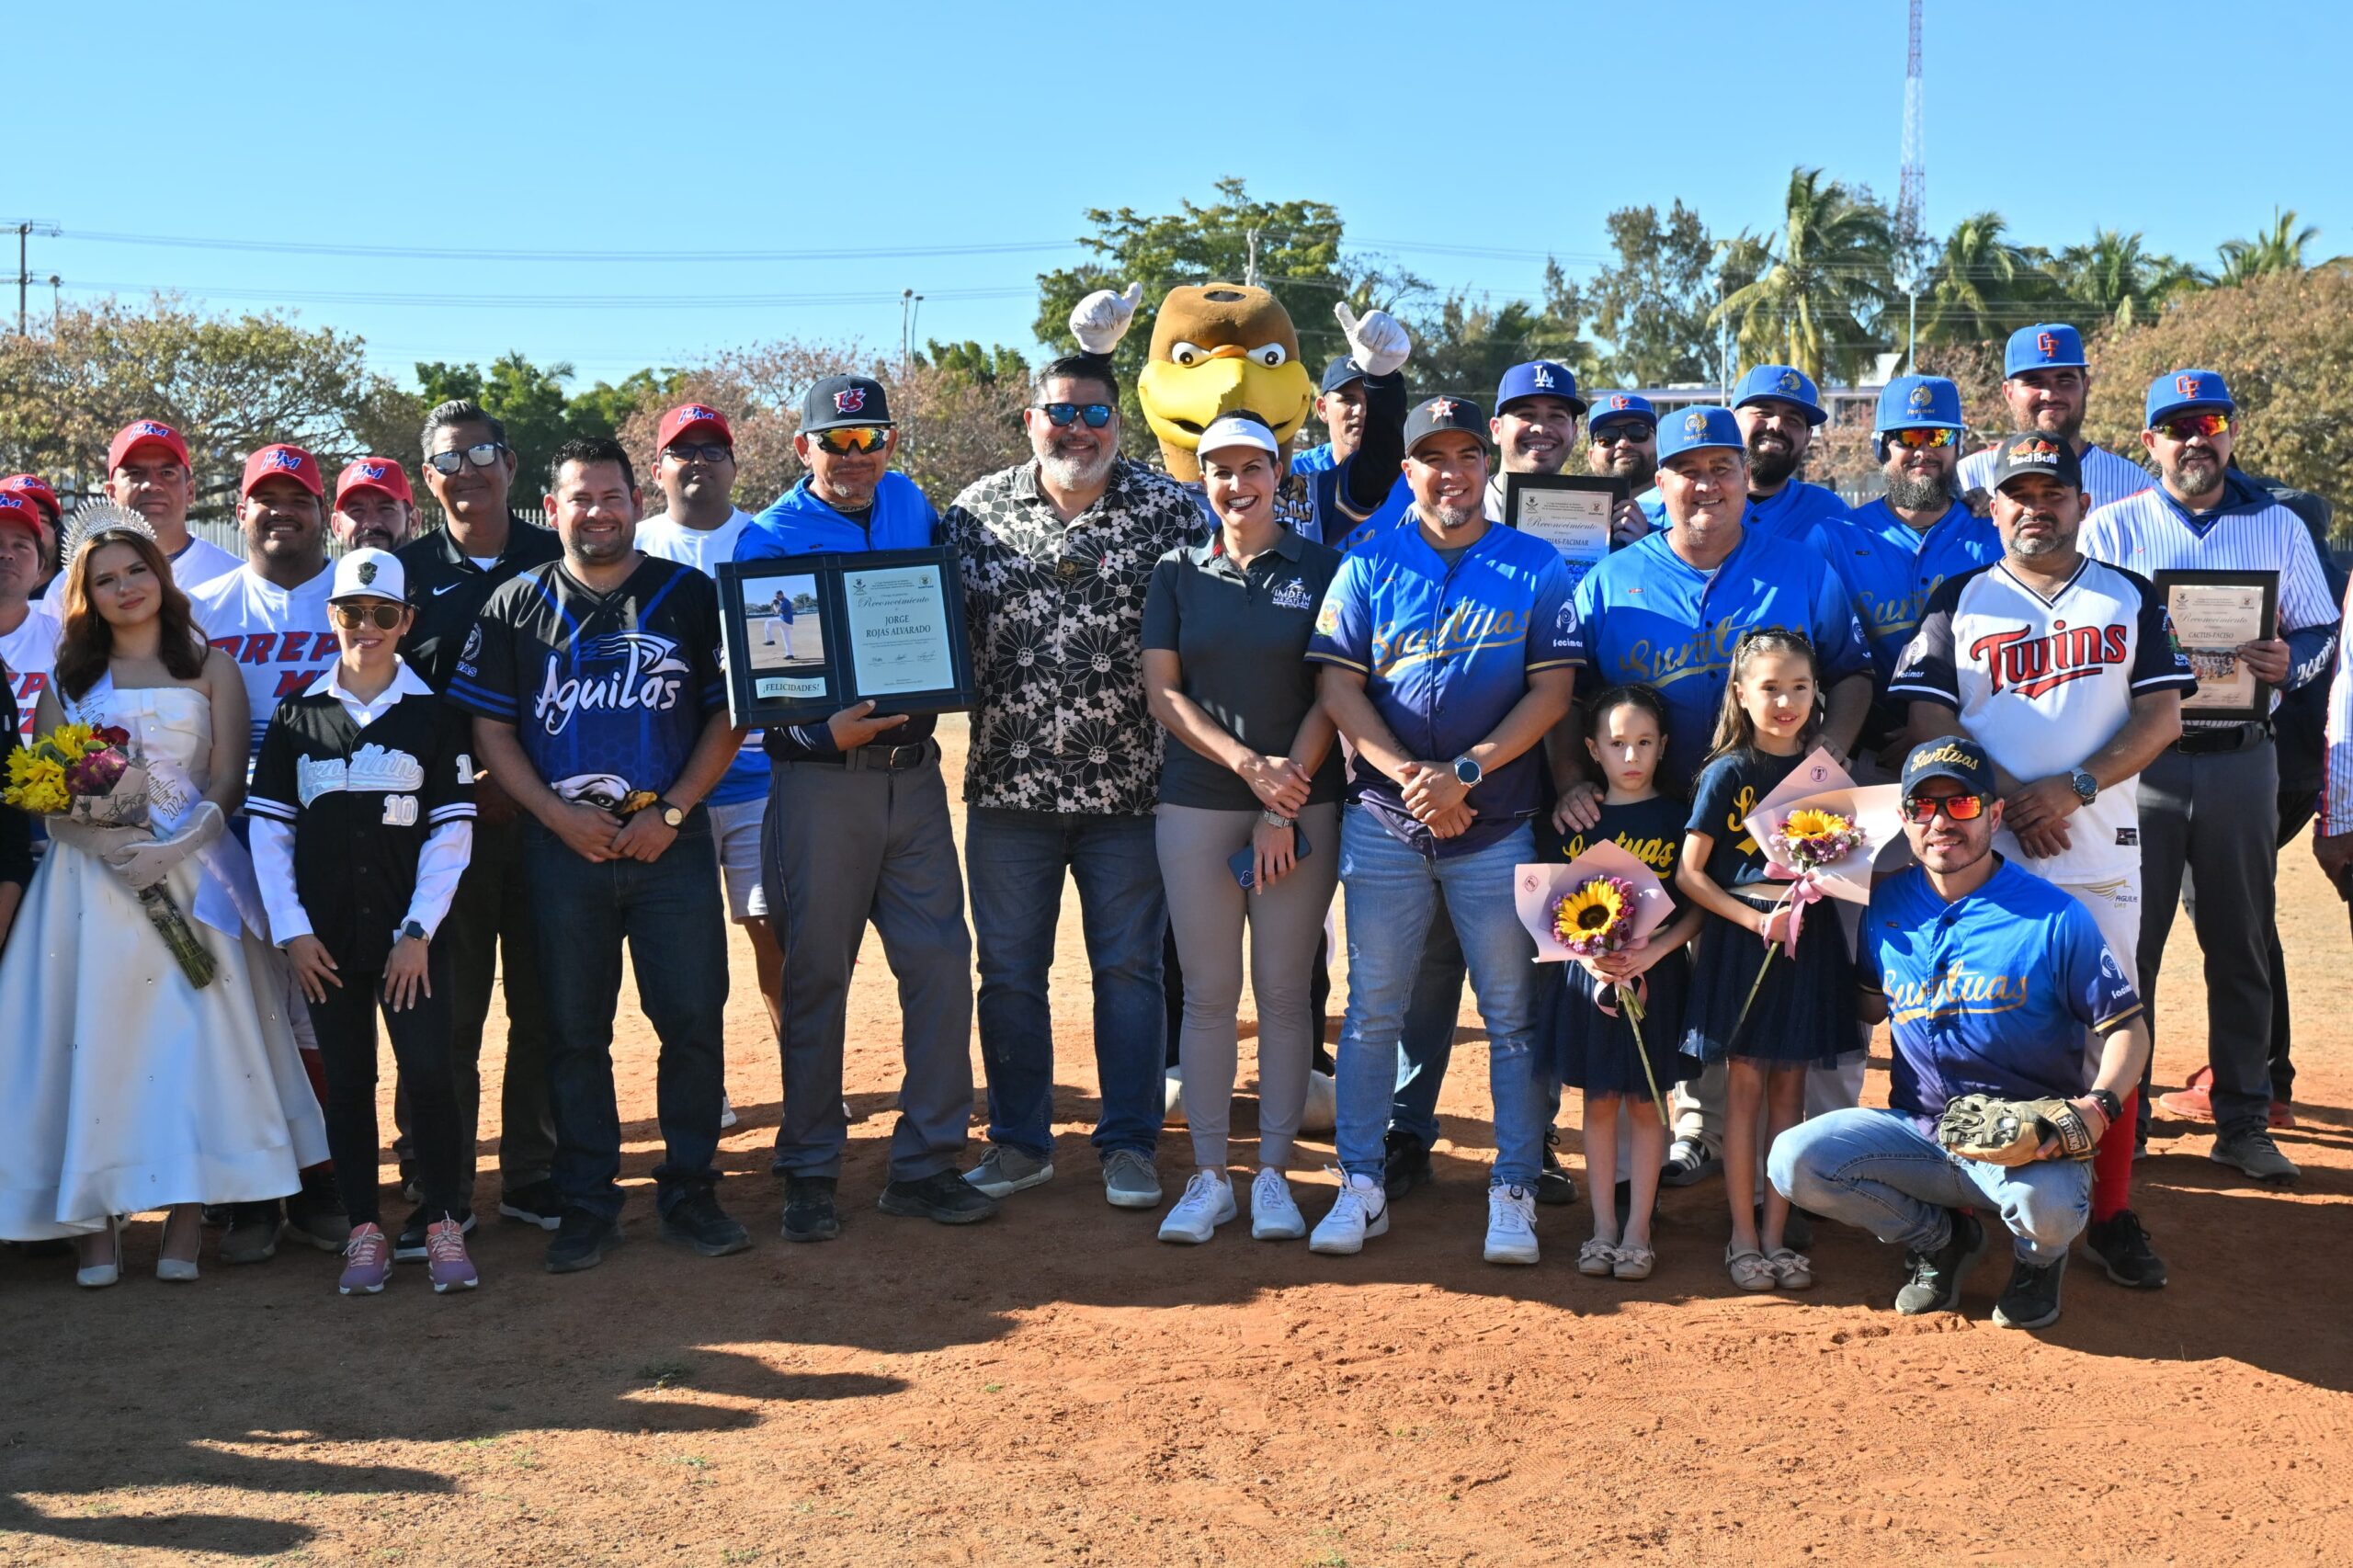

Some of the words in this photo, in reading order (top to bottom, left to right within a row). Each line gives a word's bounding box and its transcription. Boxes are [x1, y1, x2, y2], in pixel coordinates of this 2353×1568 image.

[1533, 365, 1555, 389] LA
[677, 407, 714, 426] PM
[1431, 400, 1454, 418] H
[128, 423, 168, 442] PM
[259, 449, 302, 472] PM
[2009, 451, 2033, 467] Red
[2034, 451, 2058, 465] Bull
[347, 462, 386, 486] PM
[1527, 516, 1598, 530] Reconocimiento
[858, 596, 930, 608] Reconocimiento
[885, 615, 910, 626] JORGE
[2177, 611, 2248, 624] Reconocimiento
[866, 629, 890, 639] ROJAS
[891, 625, 931, 636] ALVARADO
[1969, 619, 2128, 697] Twins
[763, 683, 820, 694] ¡FELICIDADES!
[1910, 743, 1979, 772] Suntuas
[162, 790, 189, 823] 2024
[382, 794, 418, 826] 10
[1563, 831, 1675, 867] Stuas
[1883, 959, 2028, 1010] Suntuas
[2057, 1115, 2081, 1151] GONZALEZ
